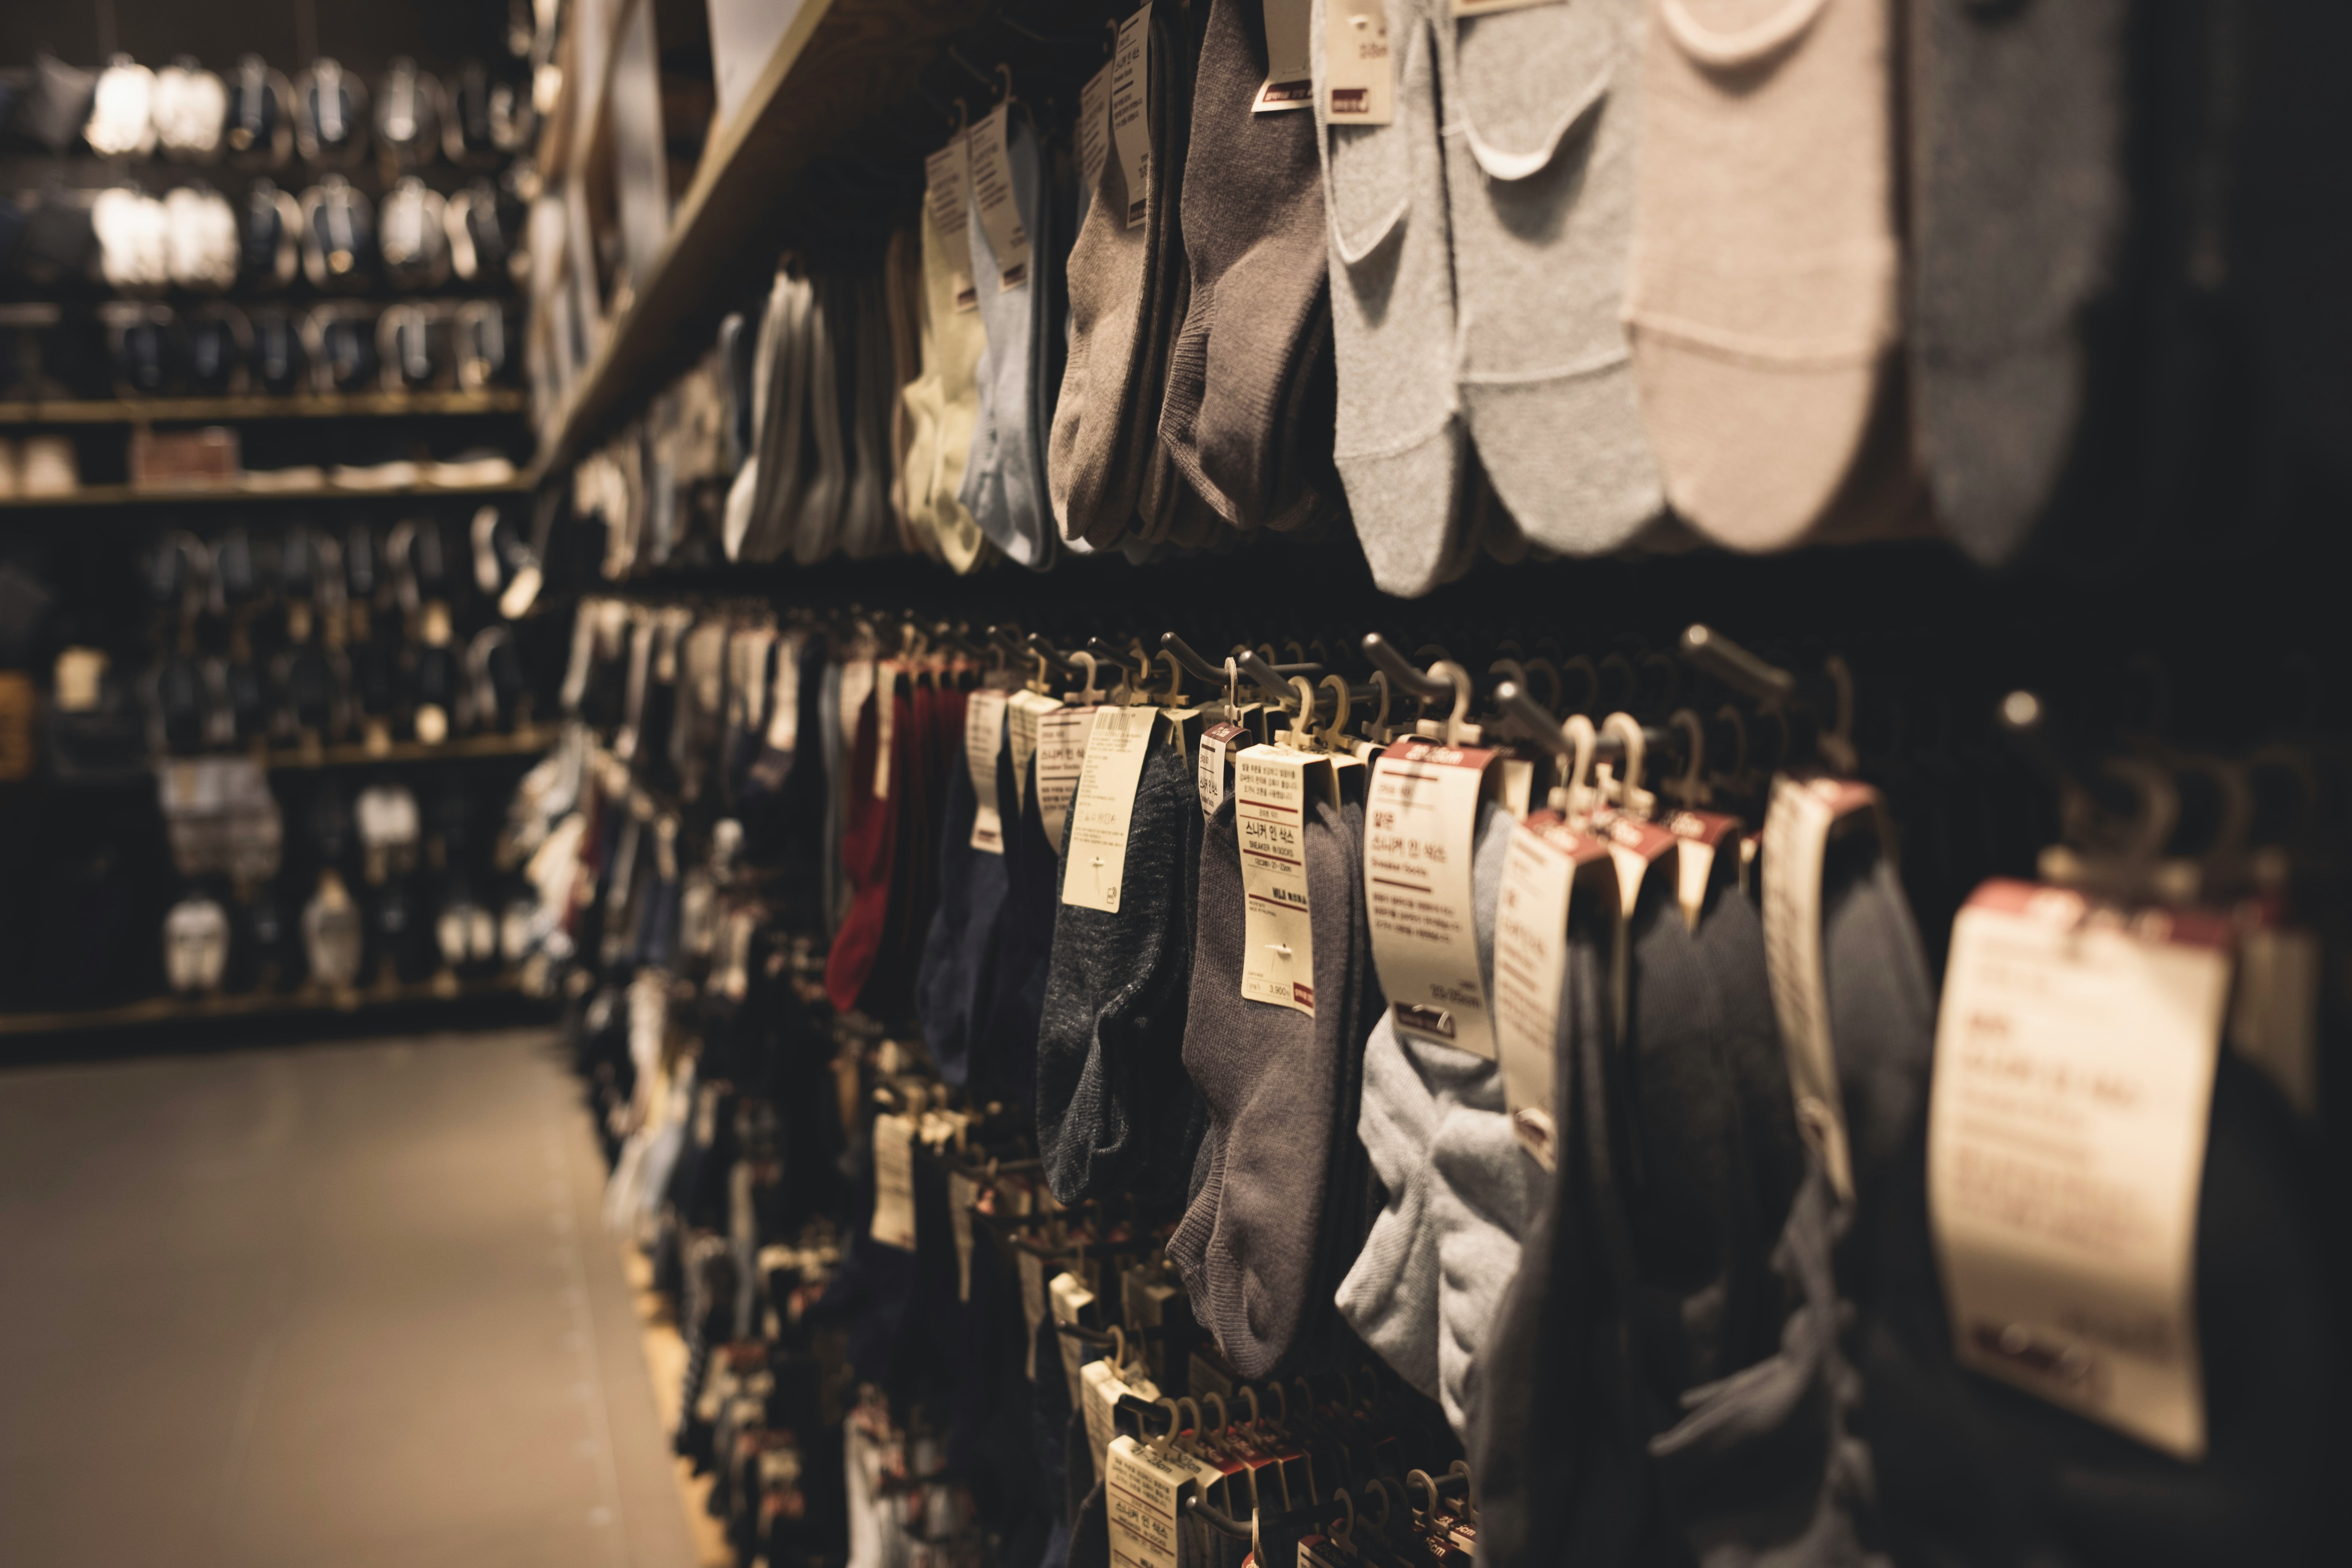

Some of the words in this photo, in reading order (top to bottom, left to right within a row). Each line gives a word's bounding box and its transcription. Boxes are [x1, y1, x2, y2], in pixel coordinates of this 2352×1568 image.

[1246, 821, 1267, 839] 스니커
[1269, 825, 1277, 841] 인
[1279, 828, 1294, 844] 삭스
